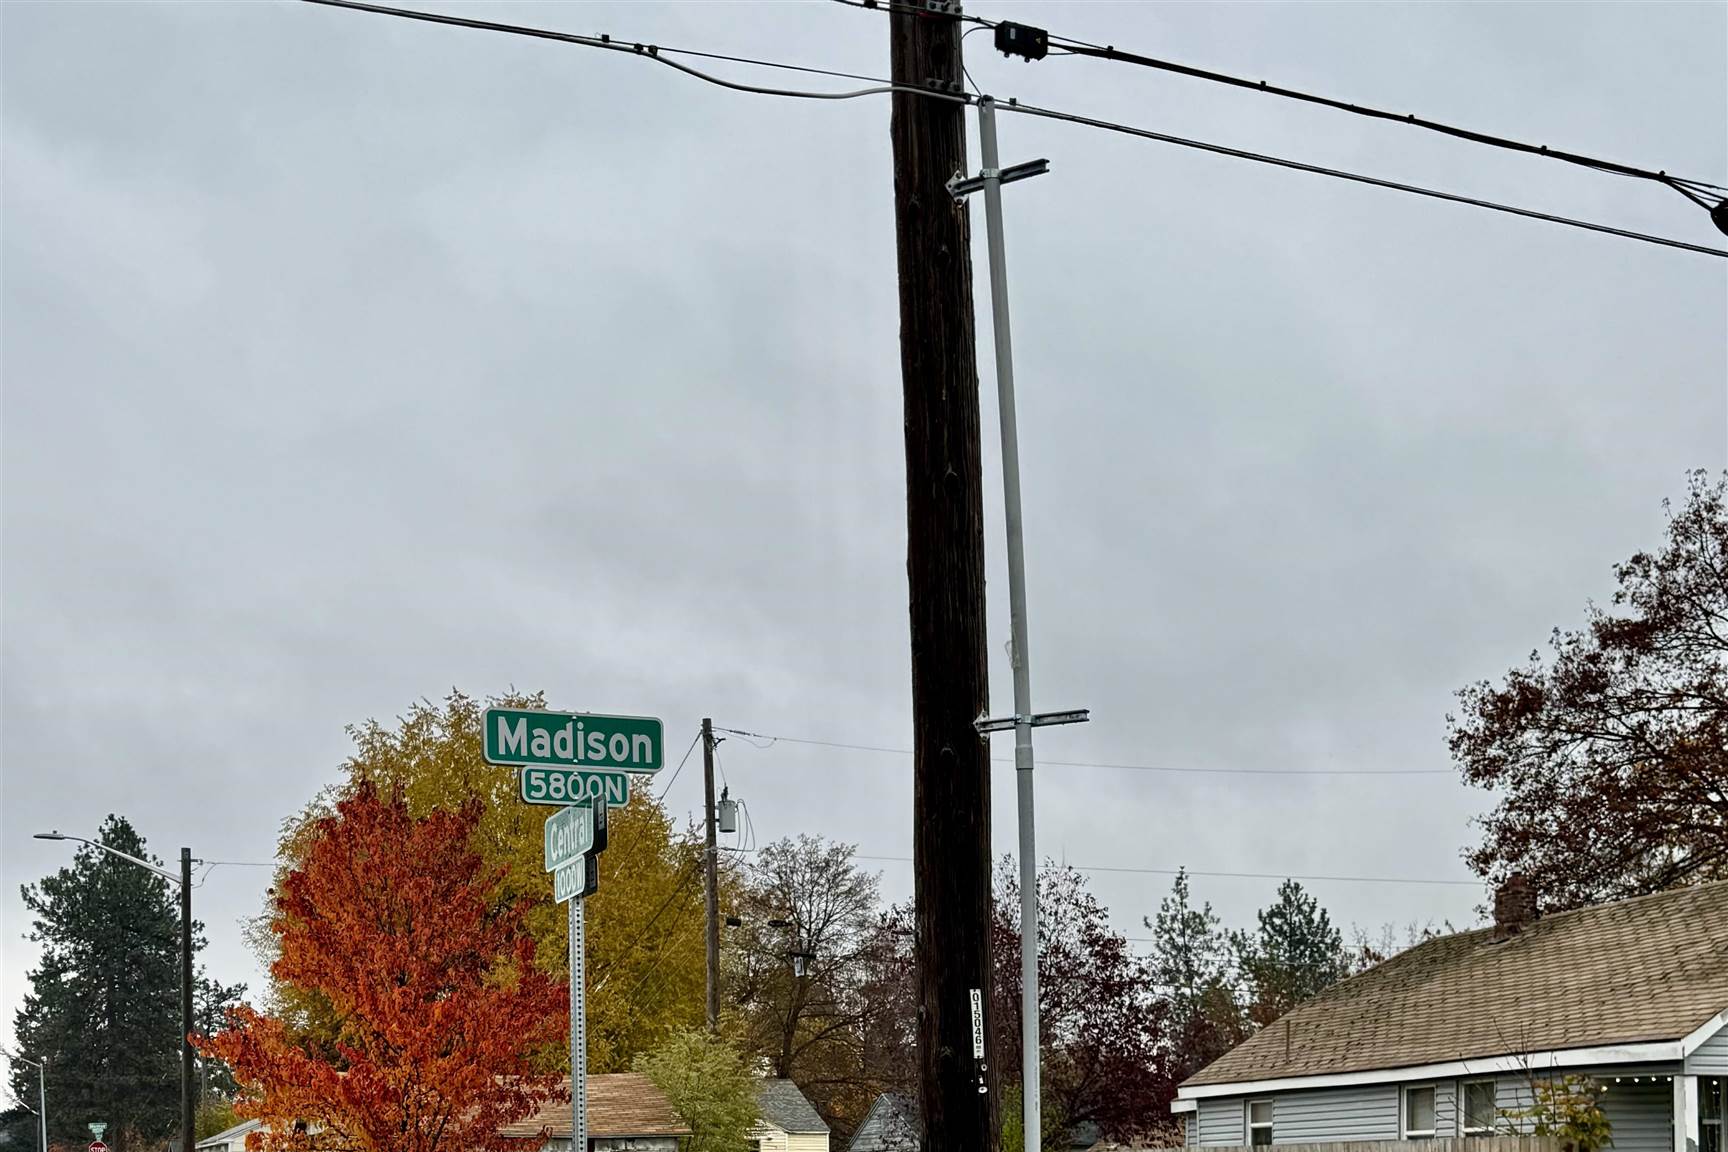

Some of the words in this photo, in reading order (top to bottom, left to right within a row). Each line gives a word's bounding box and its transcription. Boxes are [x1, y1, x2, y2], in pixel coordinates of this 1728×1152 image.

[497, 716, 653, 763] Madison
[530, 773, 623, 802] 5800N
[550, 804, 588, 862] Central
[972, 993, 982, 1044] 015046
